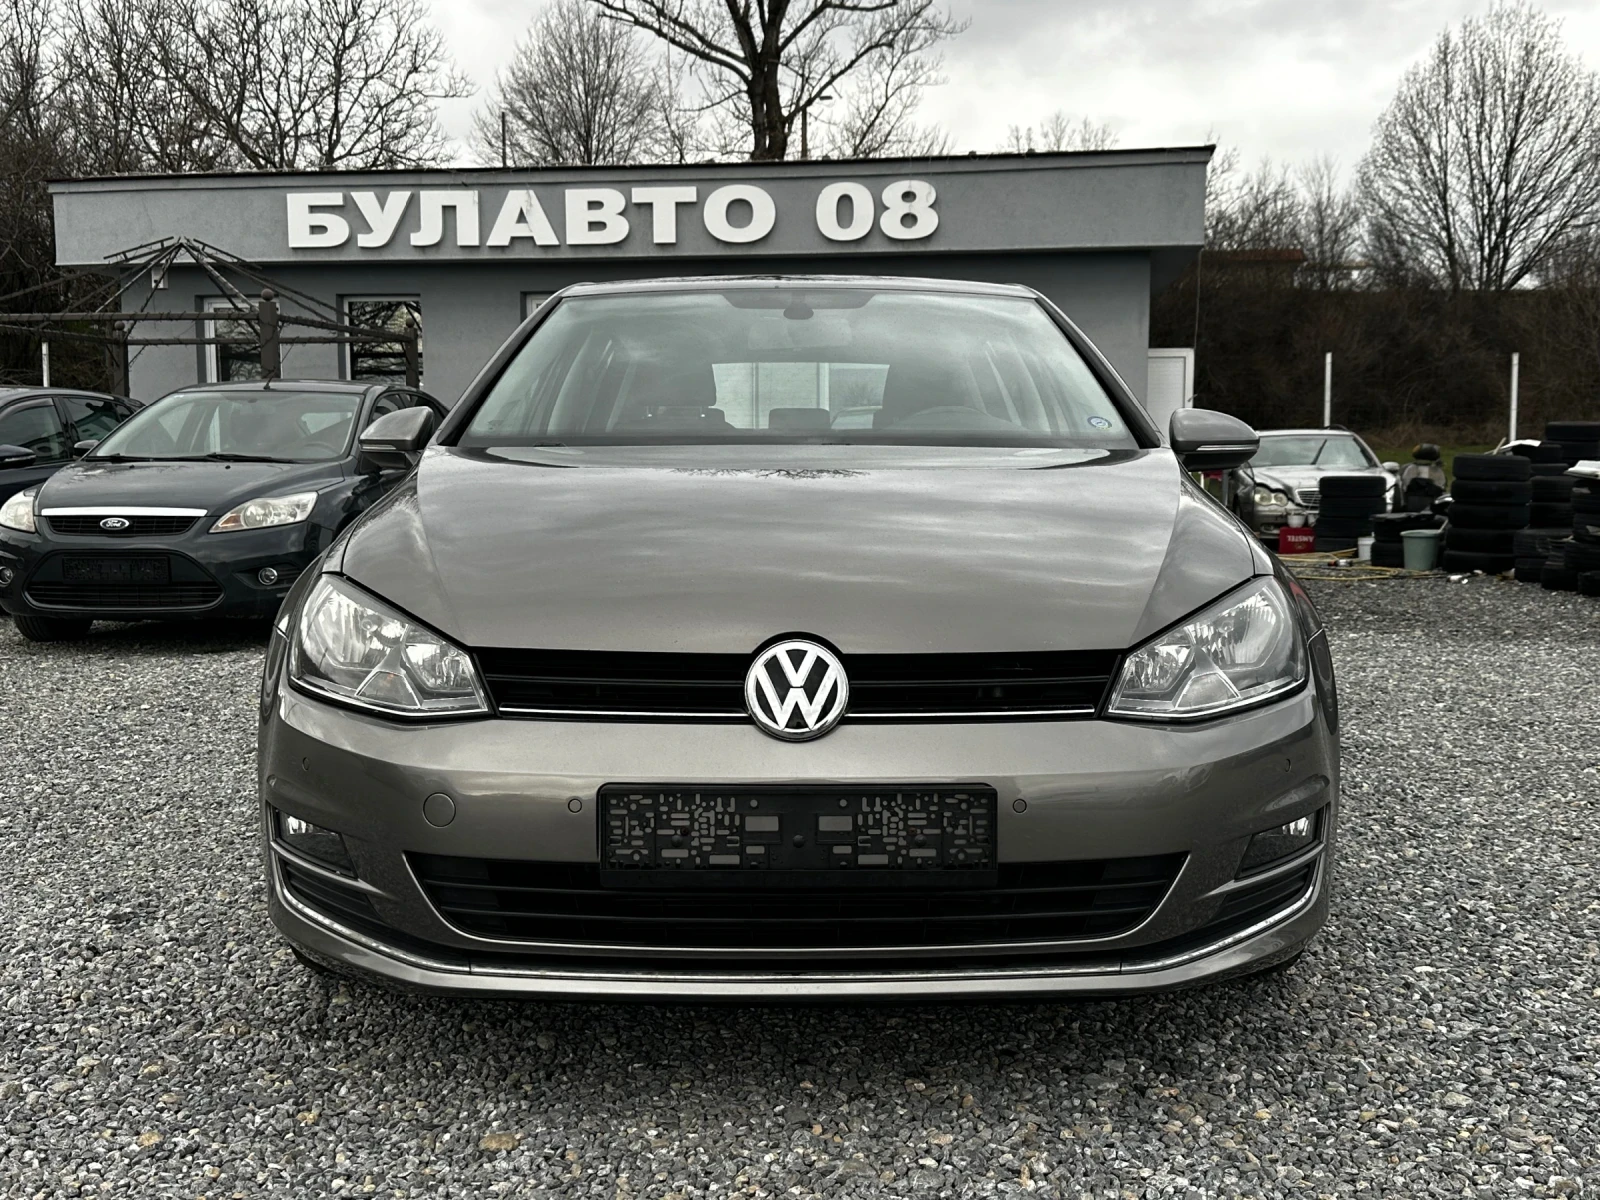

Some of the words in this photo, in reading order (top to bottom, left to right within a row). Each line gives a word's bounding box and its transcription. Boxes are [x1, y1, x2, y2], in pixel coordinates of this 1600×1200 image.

[286, 184, 776, 248] БУЛАВТО
[816, 180, 939, 241] 08
[751, 643, 843, 732] VW
